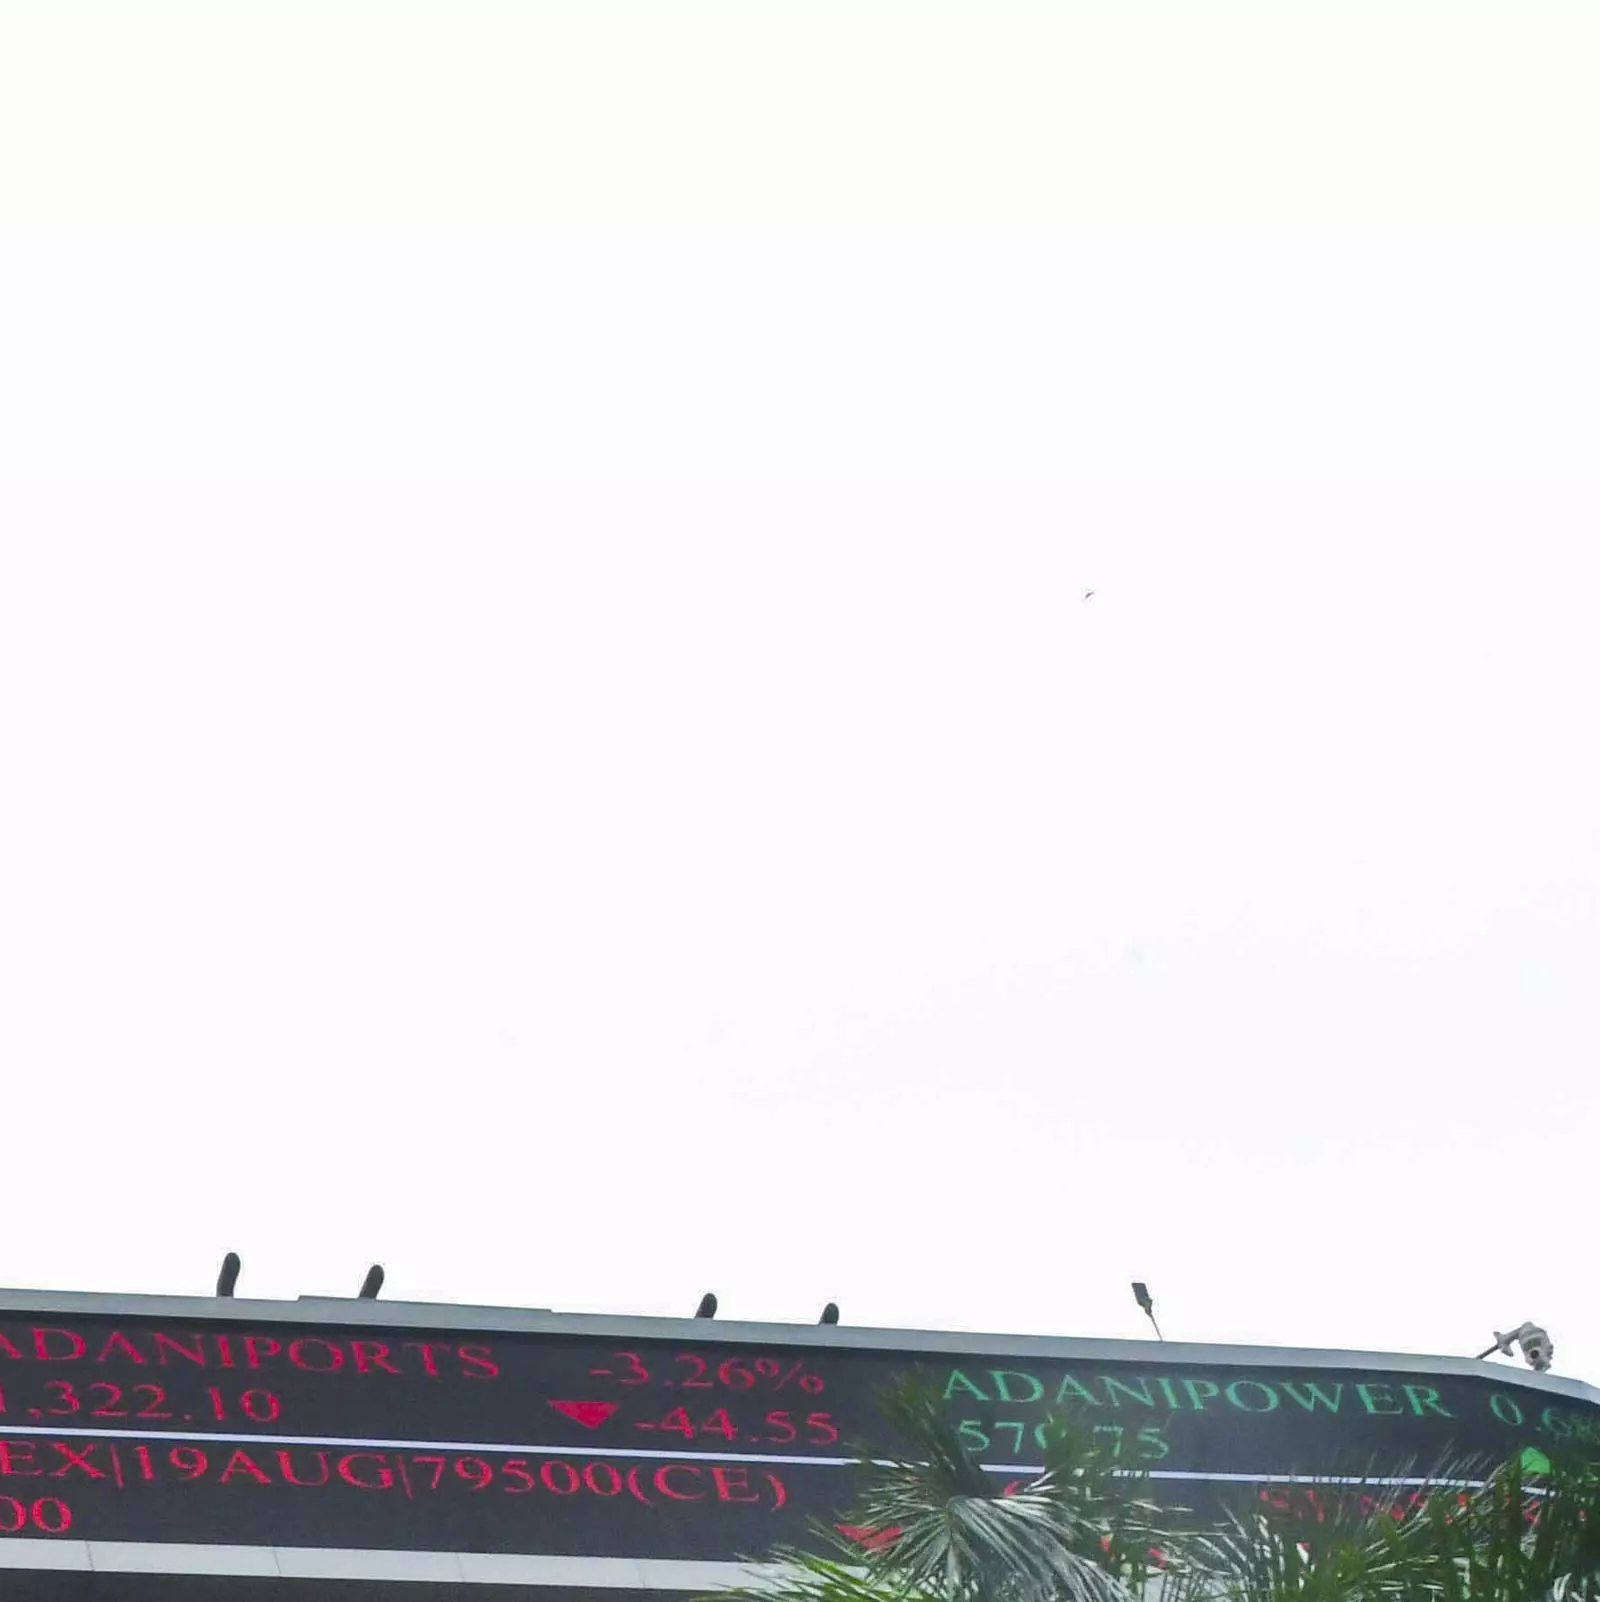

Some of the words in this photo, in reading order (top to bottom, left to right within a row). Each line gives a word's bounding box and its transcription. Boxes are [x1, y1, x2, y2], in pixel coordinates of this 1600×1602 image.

[589, 1352, 824, 1395] -3.26%
[943, 1369, 1456, 1420] ADANIPOWER
[635, 1406, 841, 1445] -44.55
